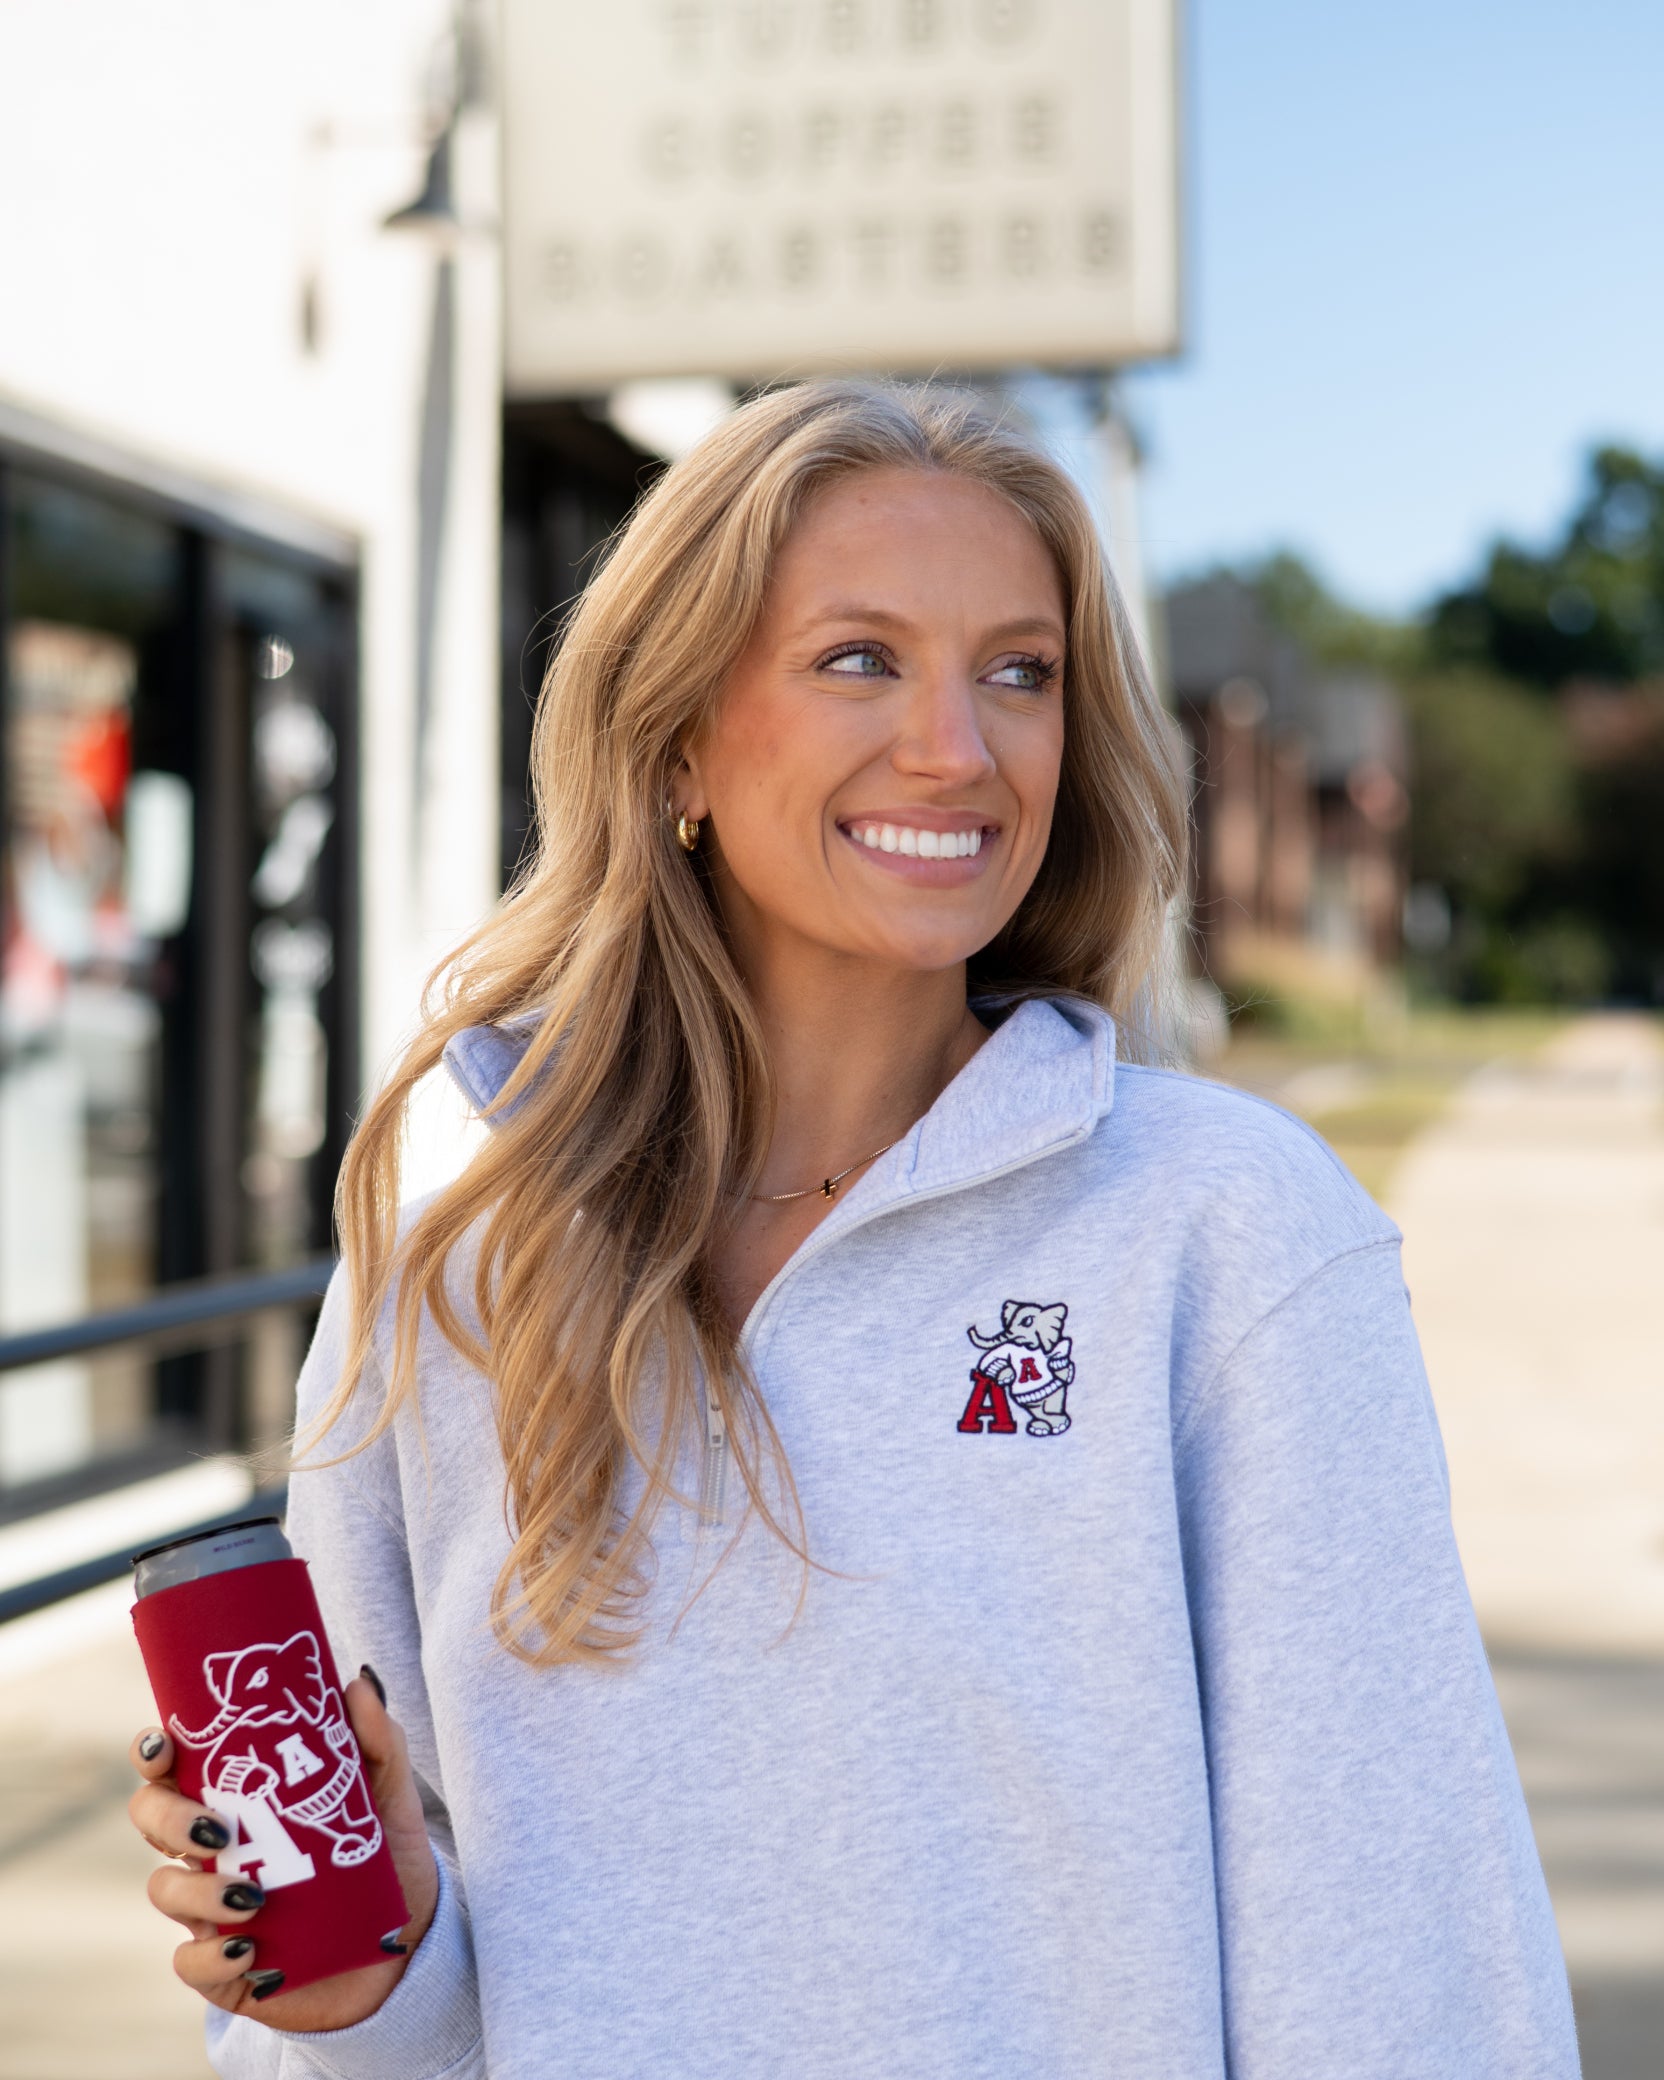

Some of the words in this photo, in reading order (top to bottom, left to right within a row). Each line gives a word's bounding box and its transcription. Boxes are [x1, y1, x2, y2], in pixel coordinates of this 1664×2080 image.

[642, 90, 1056, 190] COFFEE
[540, 202, 1132, 309] ROASTERS
[957, 1368, 1018, 1434] A
[1018, 1357, 1043, 1384] A
[275, 1732, 326, 1788] A
[201, 1785, 317, 1892] A
